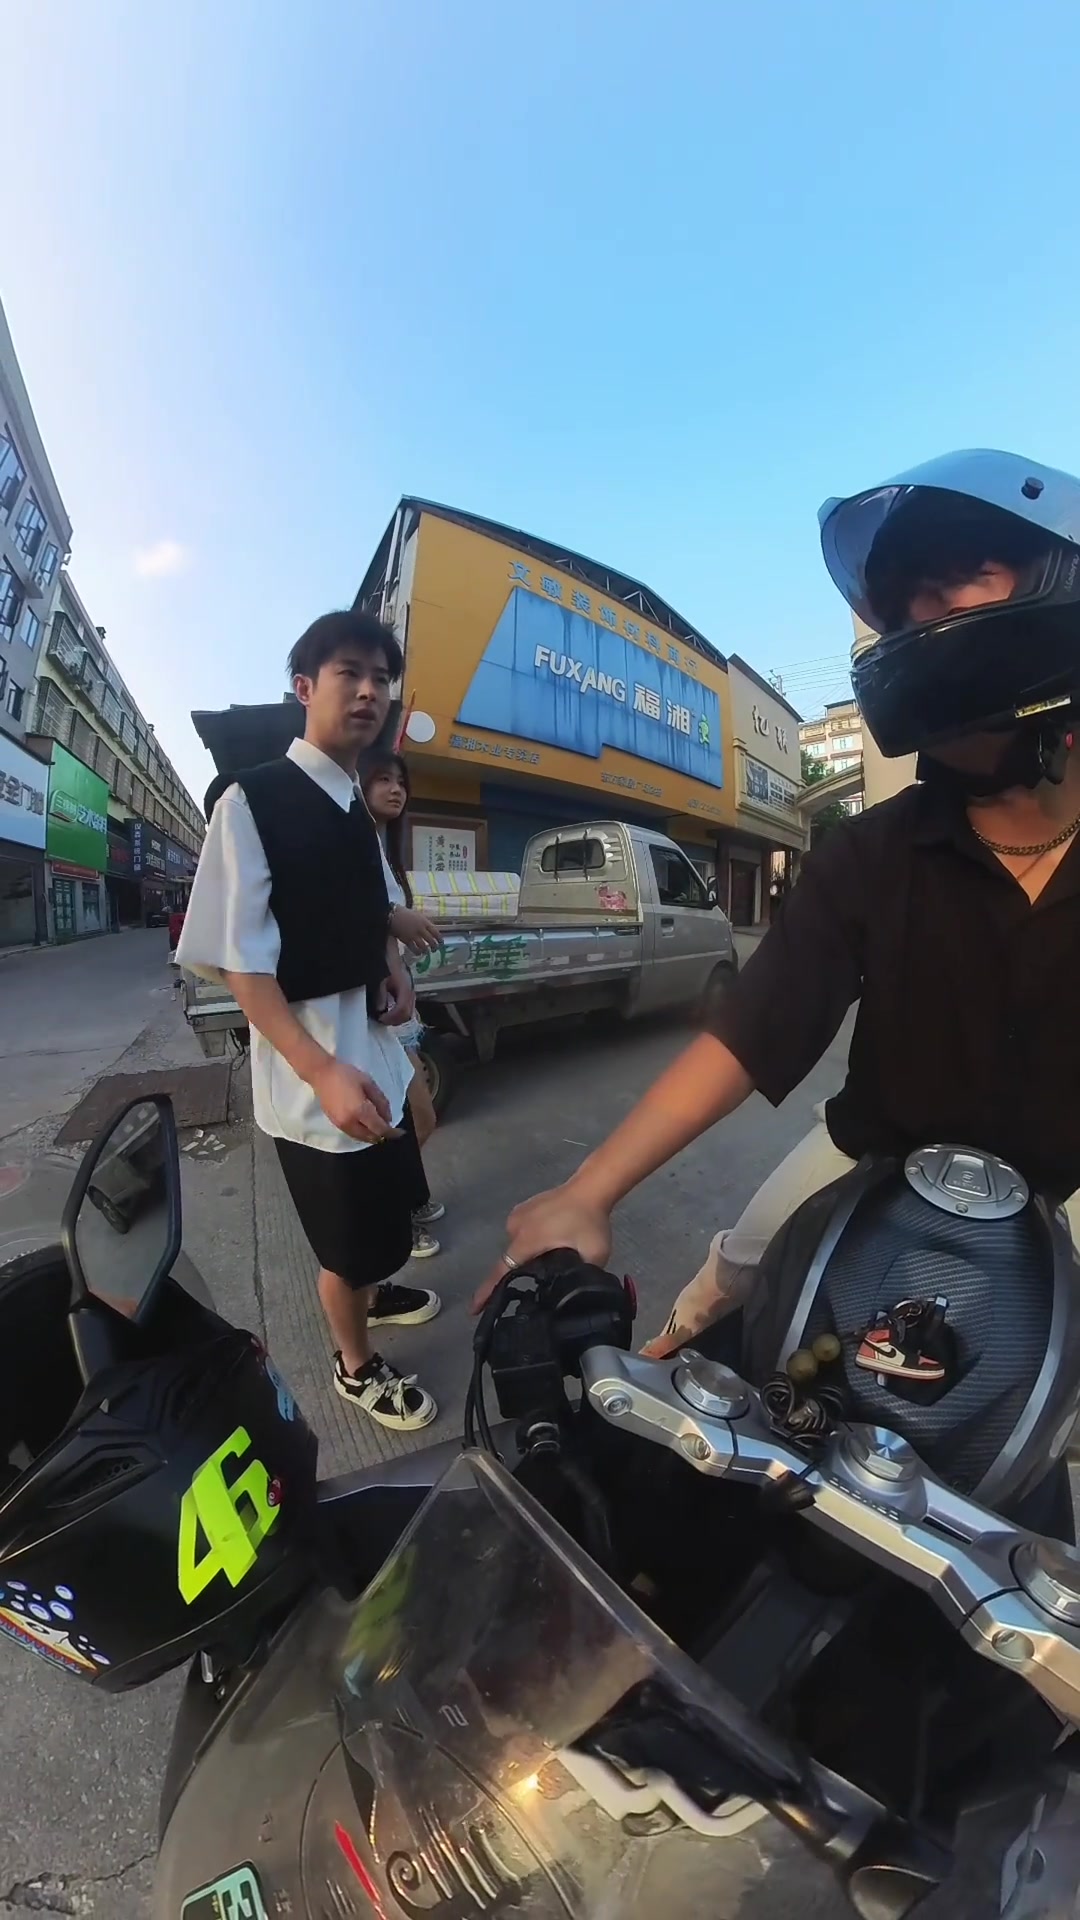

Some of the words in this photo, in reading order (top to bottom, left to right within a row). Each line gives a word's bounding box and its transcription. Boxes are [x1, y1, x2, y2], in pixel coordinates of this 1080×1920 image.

[534, 644, 626, 702] FUXANG
[633, 682, 691, 736] 福湘
[178, 1425, 281, 1605] 46
